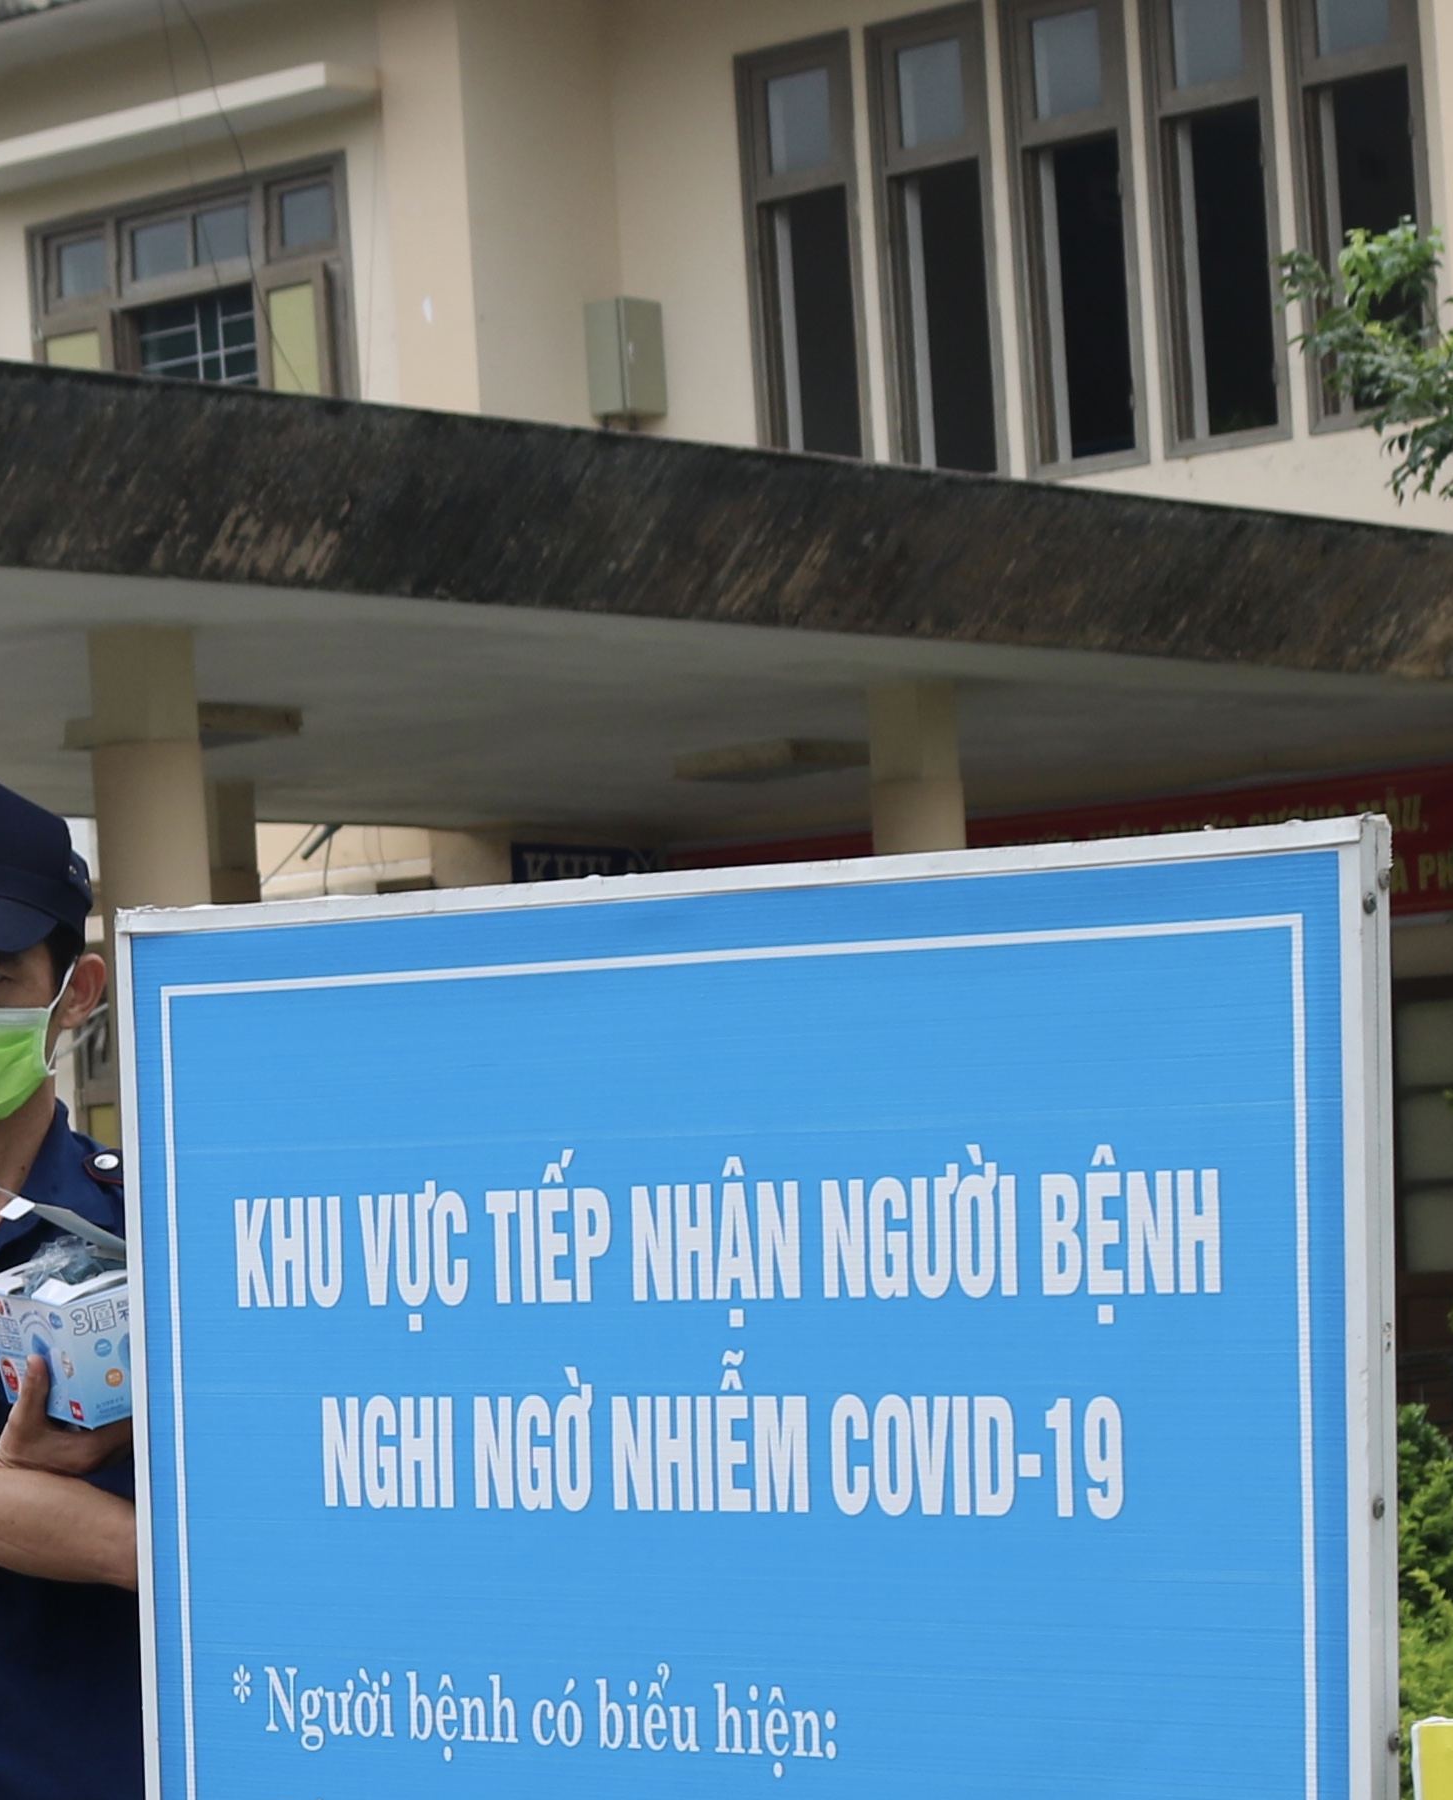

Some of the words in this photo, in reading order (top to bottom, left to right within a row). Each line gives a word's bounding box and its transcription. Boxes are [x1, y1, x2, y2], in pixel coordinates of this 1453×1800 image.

[235, 1196, 342, 1308] KHU
[359, 1181, 468, 1331] VỰC
[486, 1149, 611, 1304] TIẾP
[631, 1156, 801, 1327] NHẬN
[821, 1144, 1018, 1299] NGƯỜI
[1041, 1145, 1221, 1324] BỆNH
[322, 1395, 454, 1508] NGHI
[474, 1367, 592, 1511] NGỜ
[612, 1351, 809, 1512] NHIỄM
[831, 1394, 1124, 1519] COVID-19
[264, 1666, 394, 1751] Người
[406, 1671, 518, 1761] bệnh
[532, 1679, 583, 1747] có
[596, 1663, 700, 1752] biểu
[714, 1683, 836, 1777] hiện:
